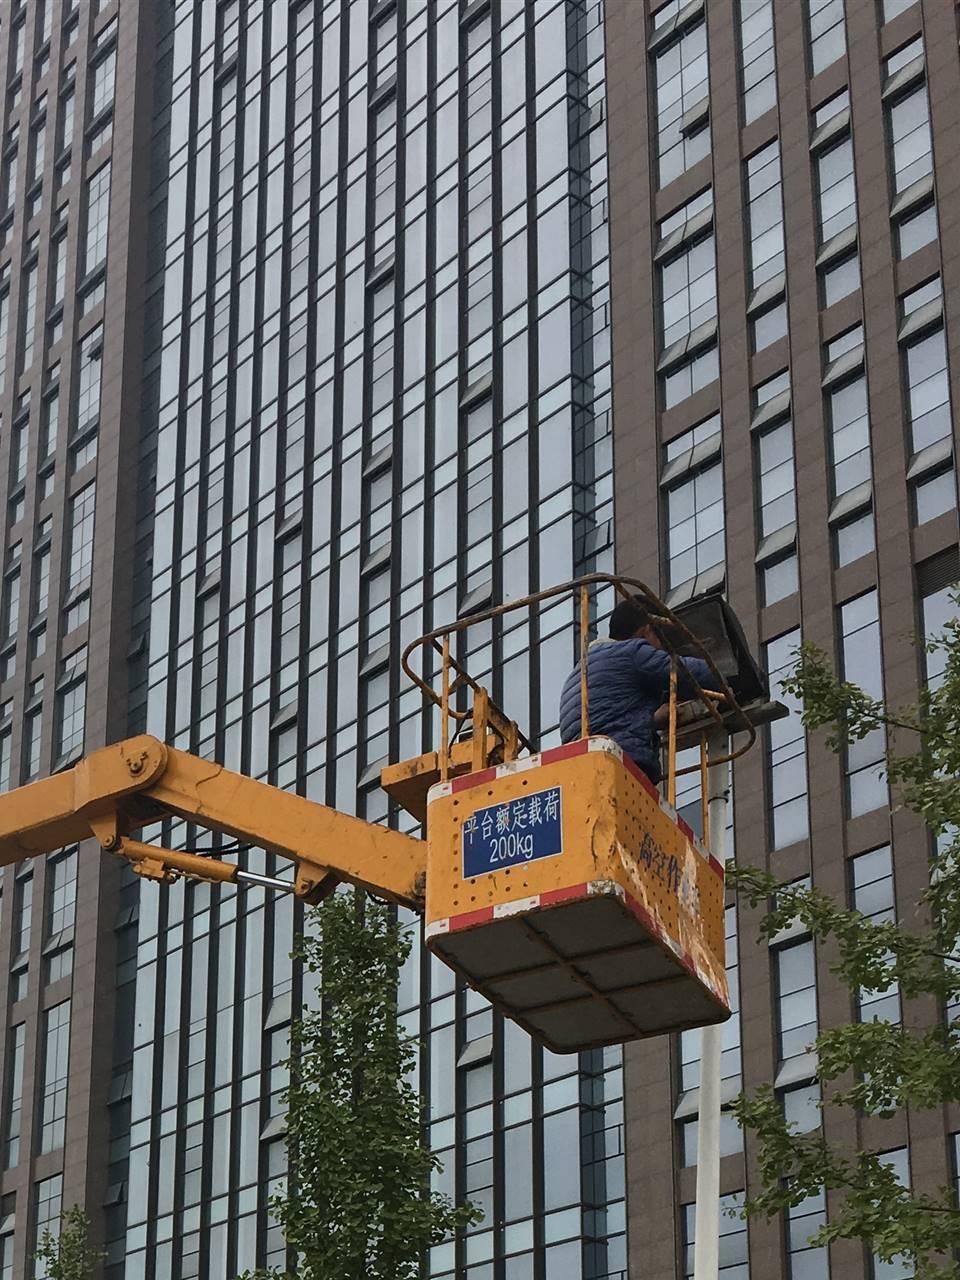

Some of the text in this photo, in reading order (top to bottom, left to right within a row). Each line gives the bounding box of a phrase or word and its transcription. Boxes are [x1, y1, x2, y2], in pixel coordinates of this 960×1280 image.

[464, 791, 559, 845] 平台额定载荷
[489, 832, 534, 863] 200kg
